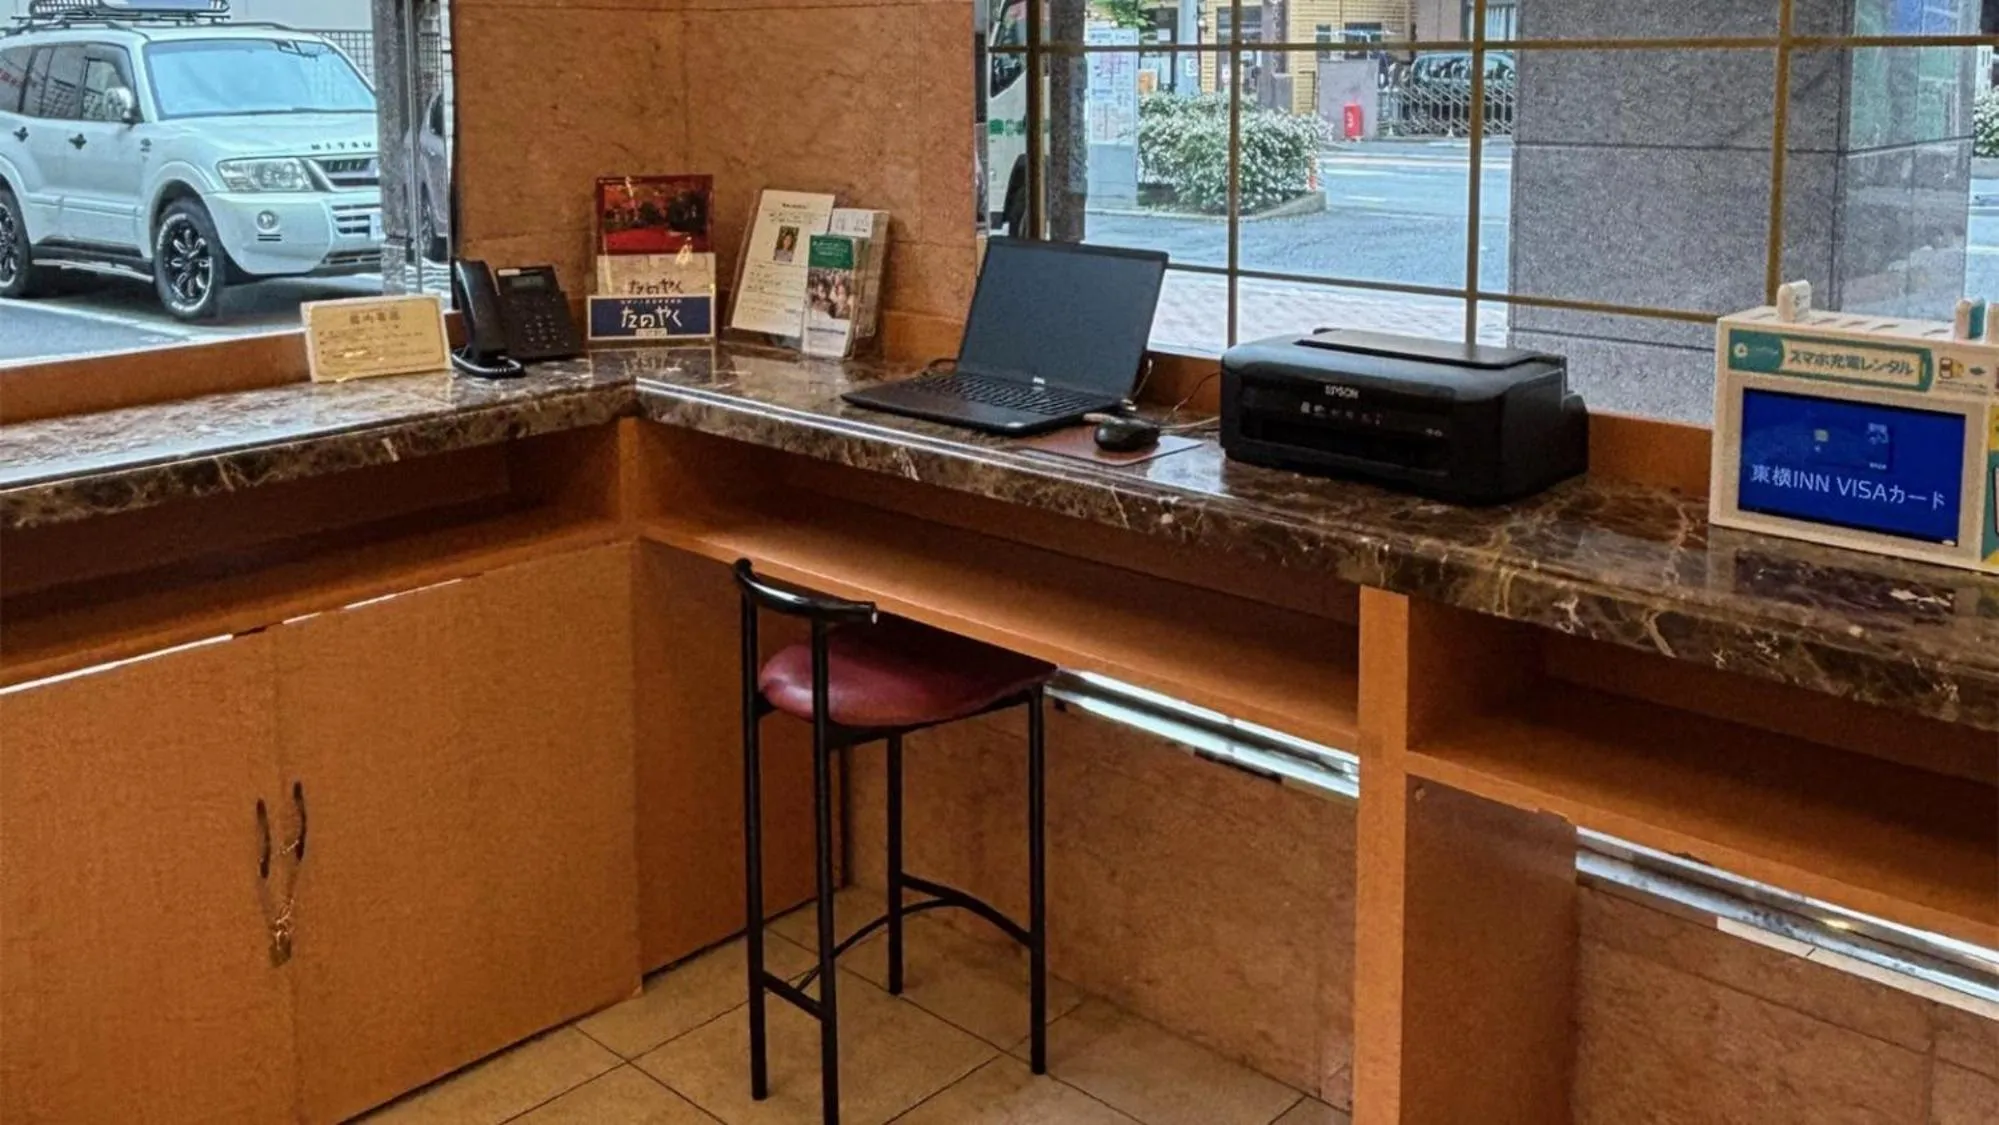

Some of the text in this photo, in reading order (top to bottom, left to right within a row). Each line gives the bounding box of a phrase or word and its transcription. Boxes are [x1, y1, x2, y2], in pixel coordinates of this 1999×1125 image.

[620, 304, 683, 329] たのやく
[1790, 350, 1914, 375] スマホ充電レンタル
[1324, 384, 1360, 399] EPSON
[1750, 463, 1946, 511] 東横INN VISAカード
